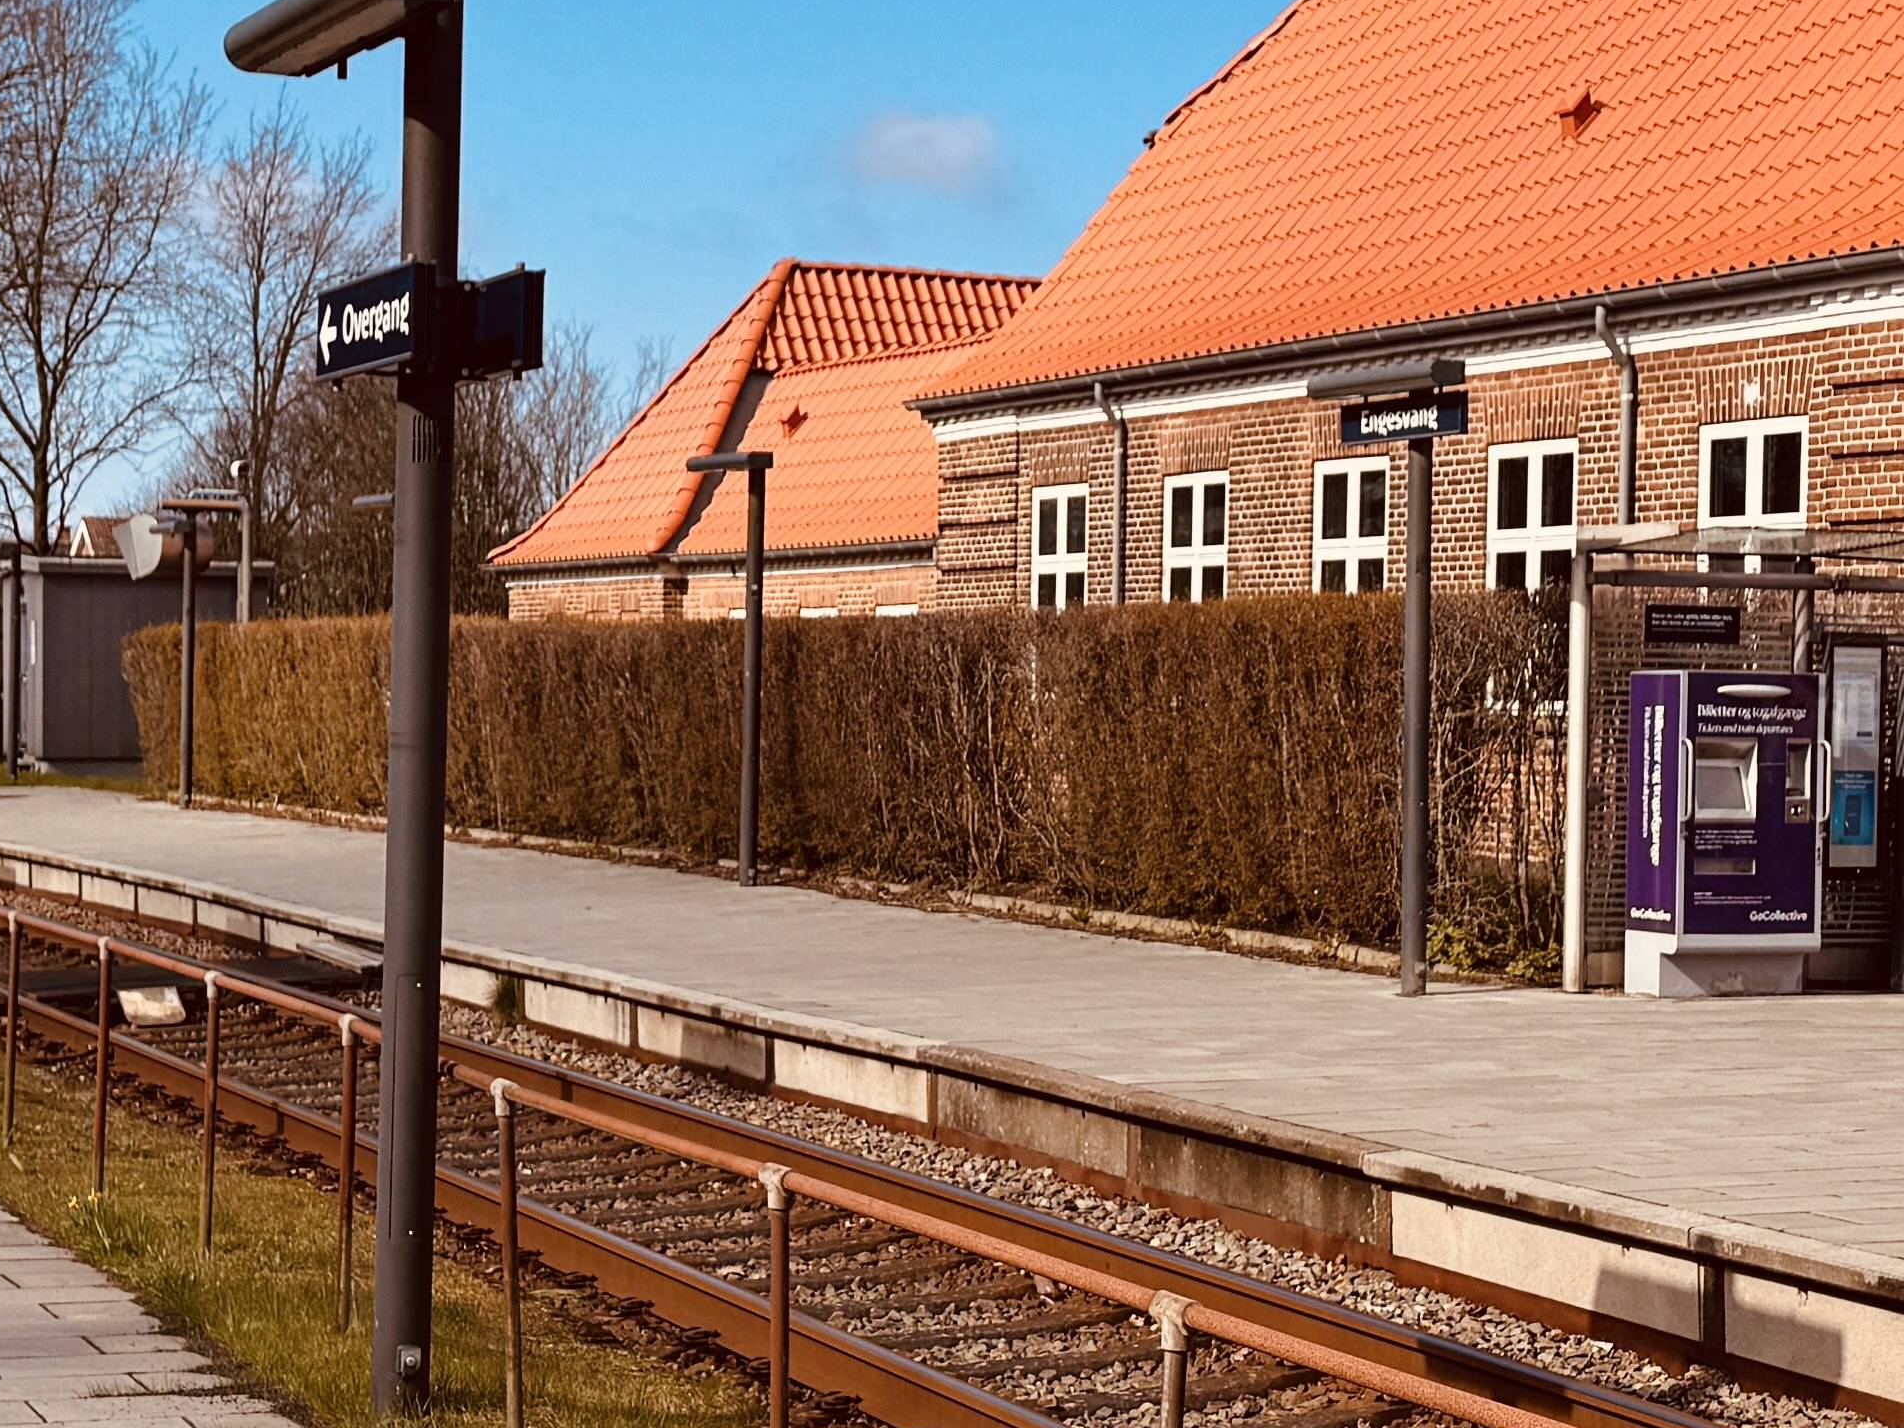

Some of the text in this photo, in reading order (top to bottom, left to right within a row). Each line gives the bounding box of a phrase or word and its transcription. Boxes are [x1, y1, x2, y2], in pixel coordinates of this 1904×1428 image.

[342, 291, 410, 345] Overgang
[1360, 405, 1438, 436] Engesvang
[1749, 909, 1808, 921] GoCollective
